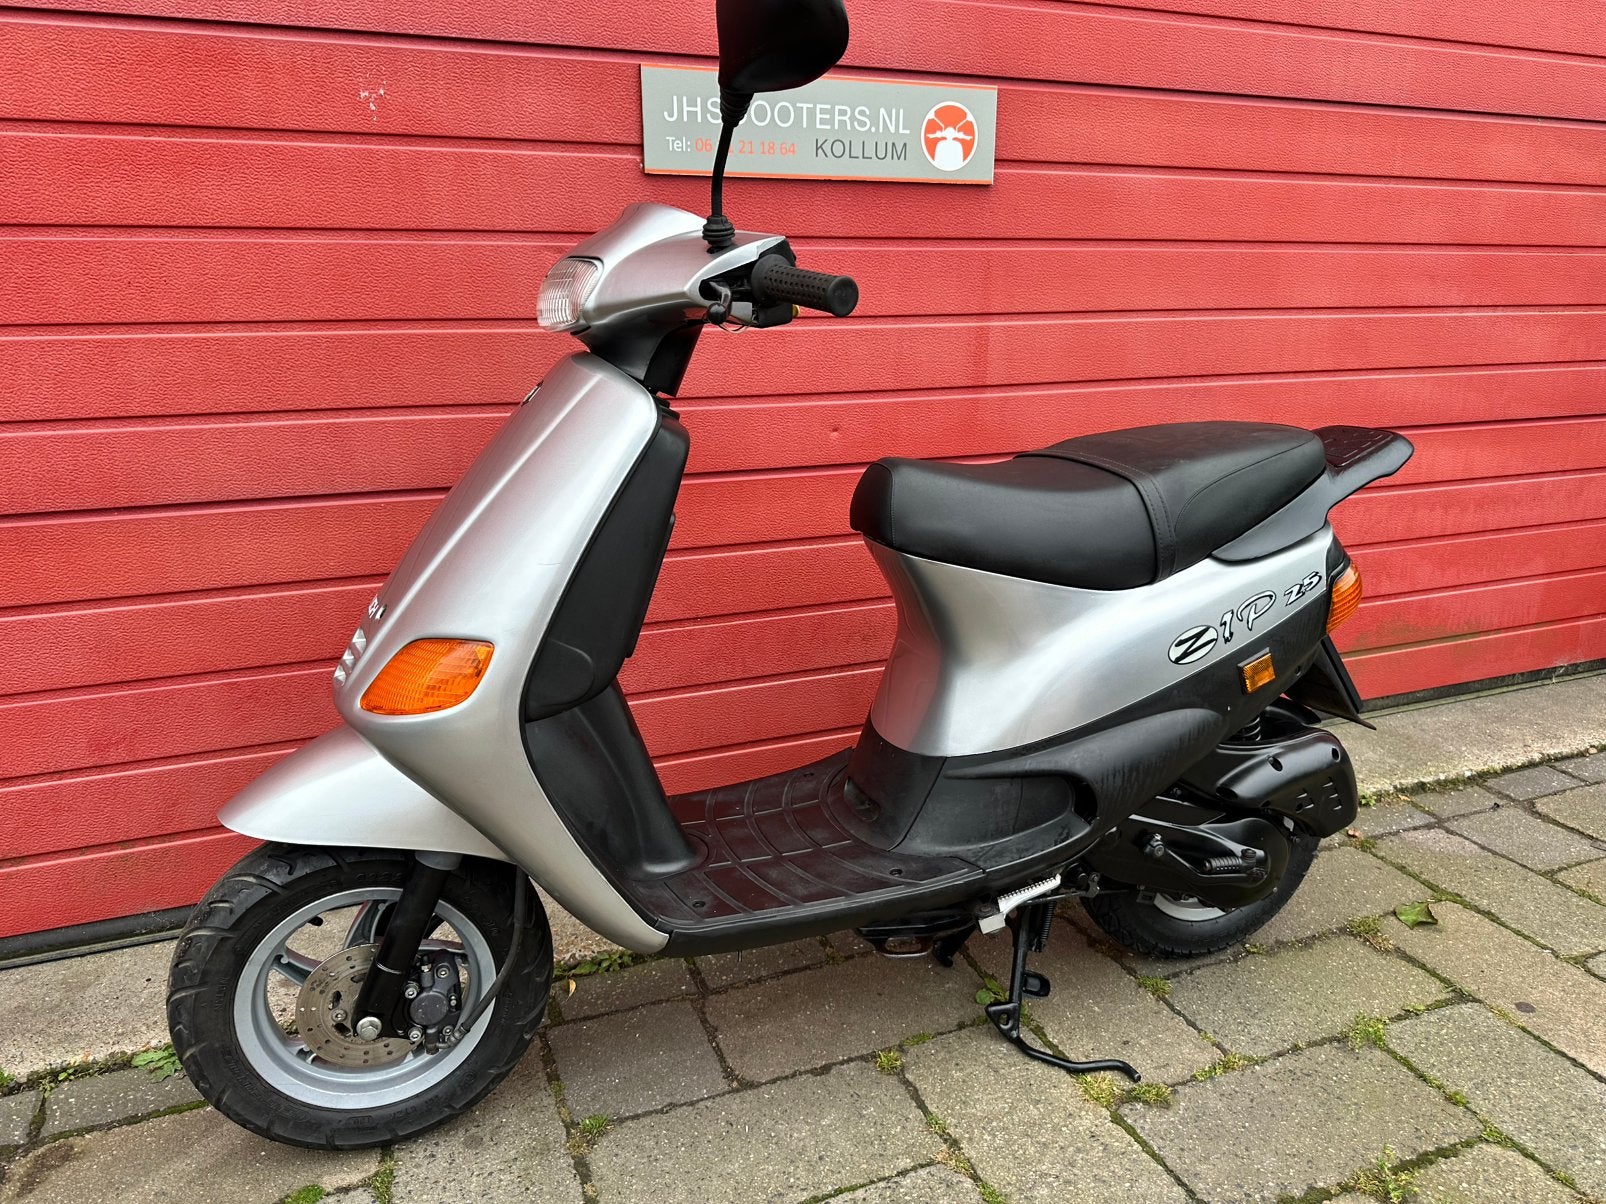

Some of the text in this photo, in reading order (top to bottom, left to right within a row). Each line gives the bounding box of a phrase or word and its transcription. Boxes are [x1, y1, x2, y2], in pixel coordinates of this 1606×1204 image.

[663, 95, 911, 134] JHSOOTERS.NL
[666, 136, 691, 151] Tel:
[695, 138, 713, 152] 06
[738, 140, 755, 154] 21
[760, 141, 776, 155] 18
[779, 142, 797, 156] 64
[815, 138, 908, 161] KOLLUM
[1284, 571, 1323, 606] 25
